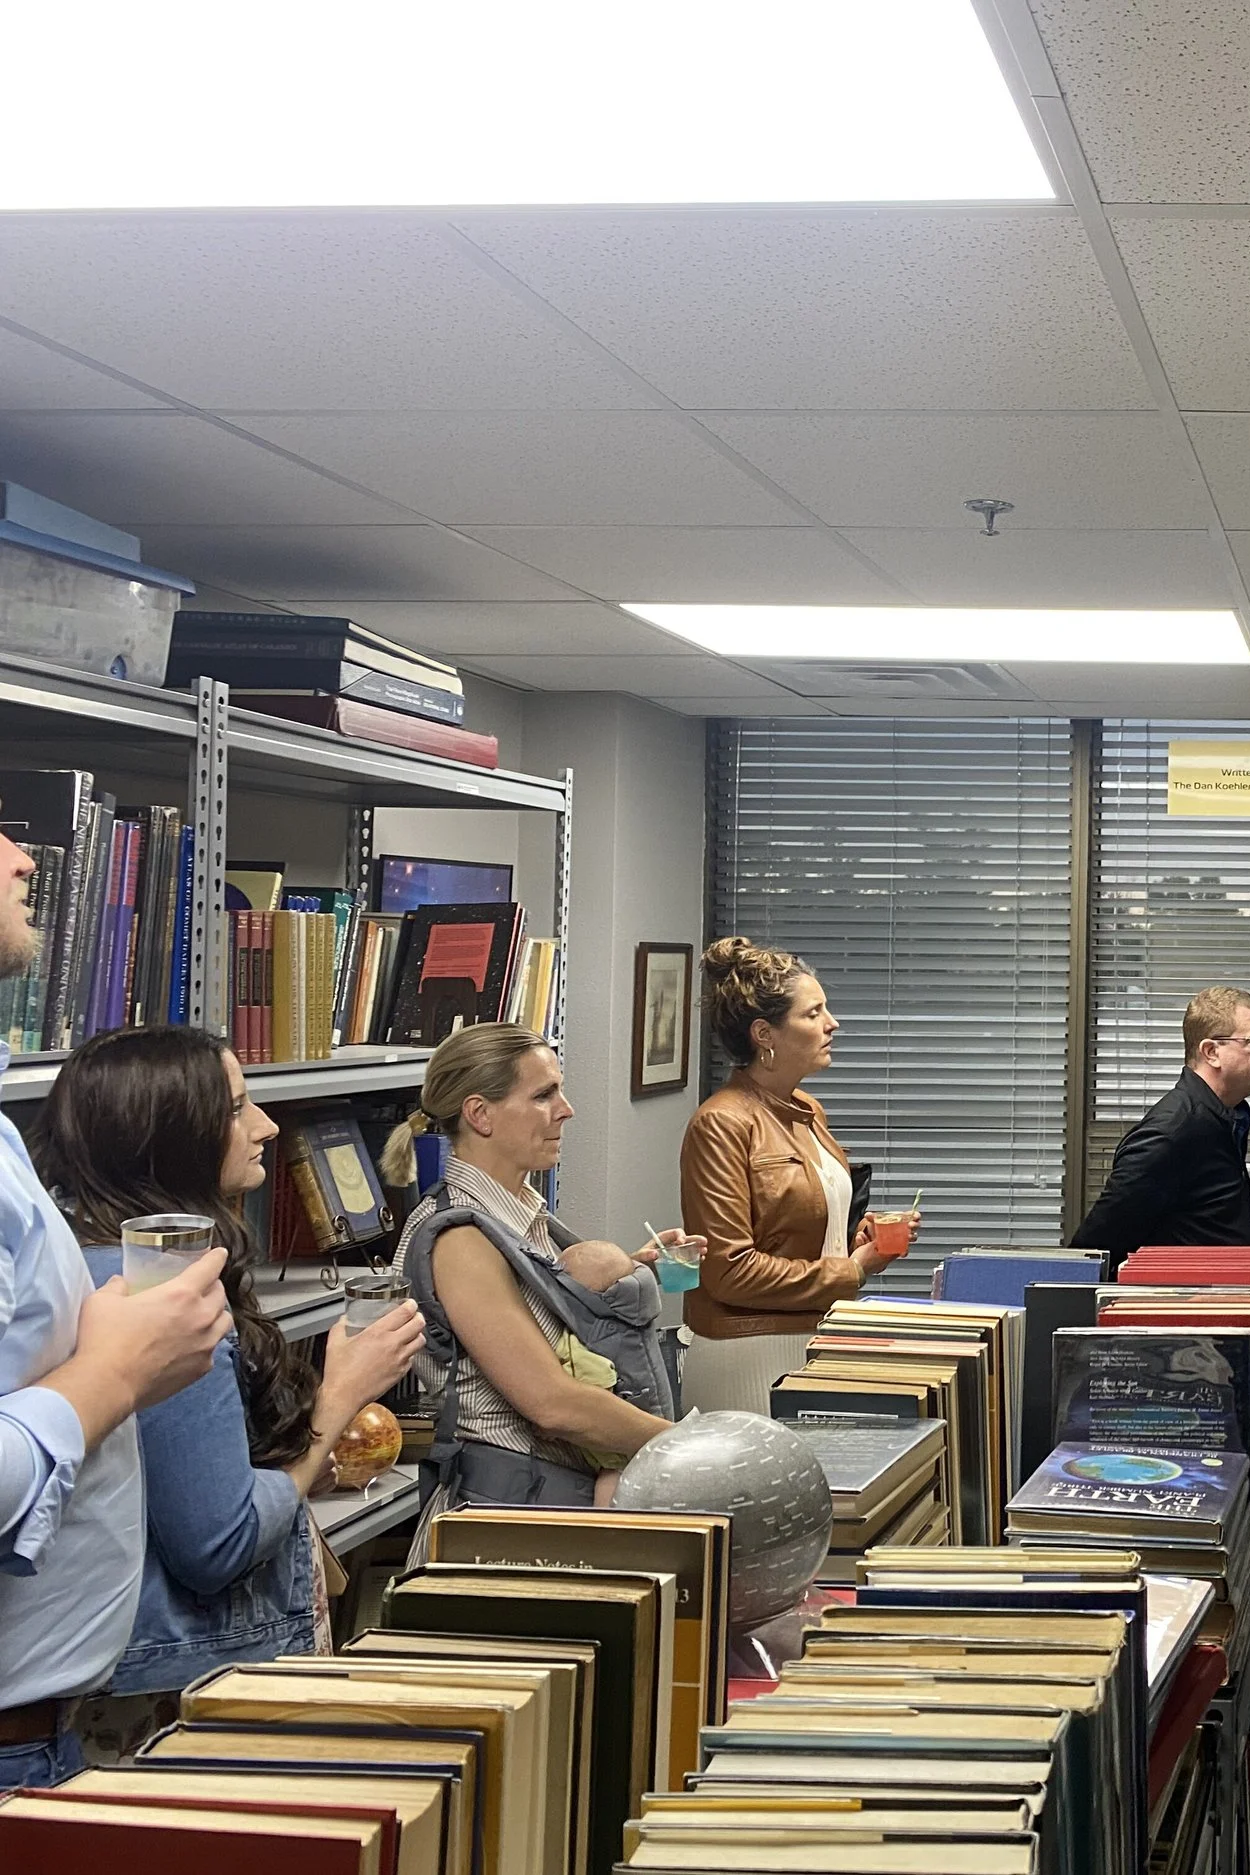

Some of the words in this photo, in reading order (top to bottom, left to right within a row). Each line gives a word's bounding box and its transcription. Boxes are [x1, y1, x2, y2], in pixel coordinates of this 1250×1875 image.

[1173, 782, 1192, 790] The
[1194, 782, 1212, 790] Dan
[79, 794, 90, 821] THE
[75, 823, 87, 856] NEW
[44, 871, 53, 893] Man
[70, 857, 82, 902] ATLAS
[1043, 1487, 1202, 1508] EARTH
